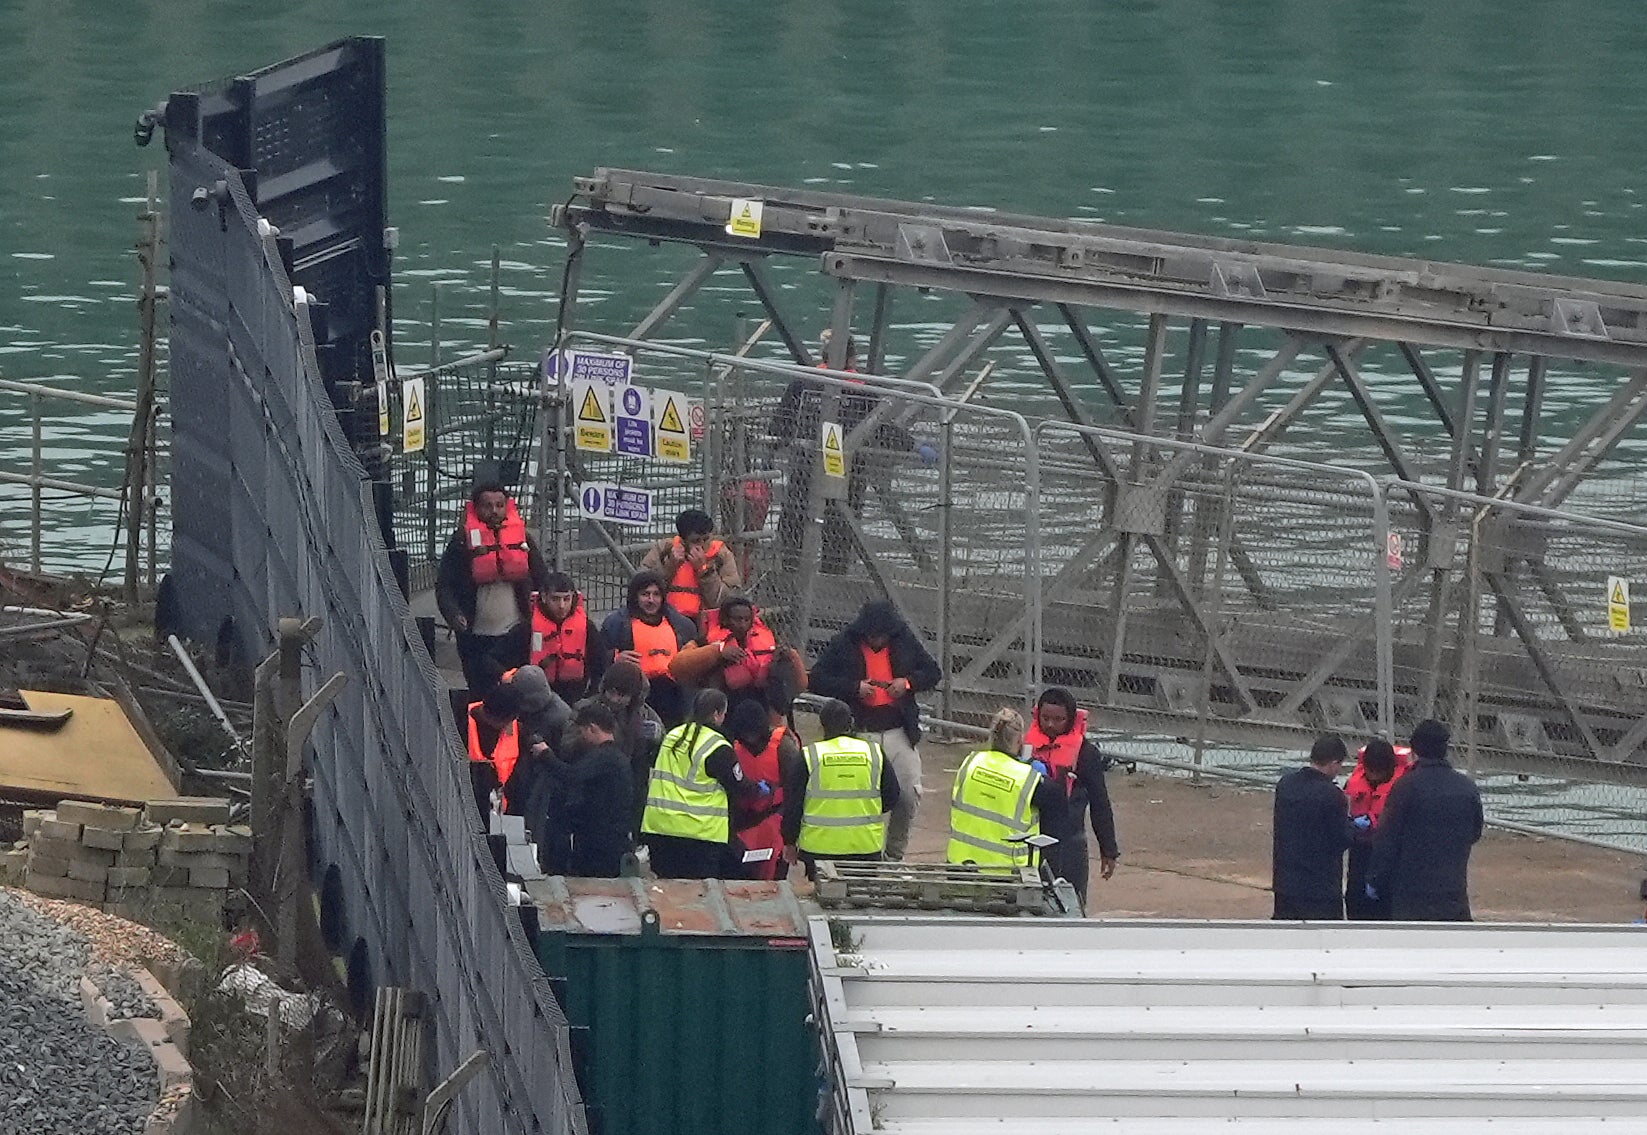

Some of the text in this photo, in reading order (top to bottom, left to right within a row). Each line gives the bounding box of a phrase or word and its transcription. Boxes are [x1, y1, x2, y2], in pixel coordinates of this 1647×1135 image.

[577, 357, 626, 369] MAXIMUM OF
[577, 364, 625, 377] 30 PERSONS
[638, 494, 647, 503] OF
[616, 500, 646, 512] PERSONS
[605, 507, 648, 520] ON LINK SPAN
